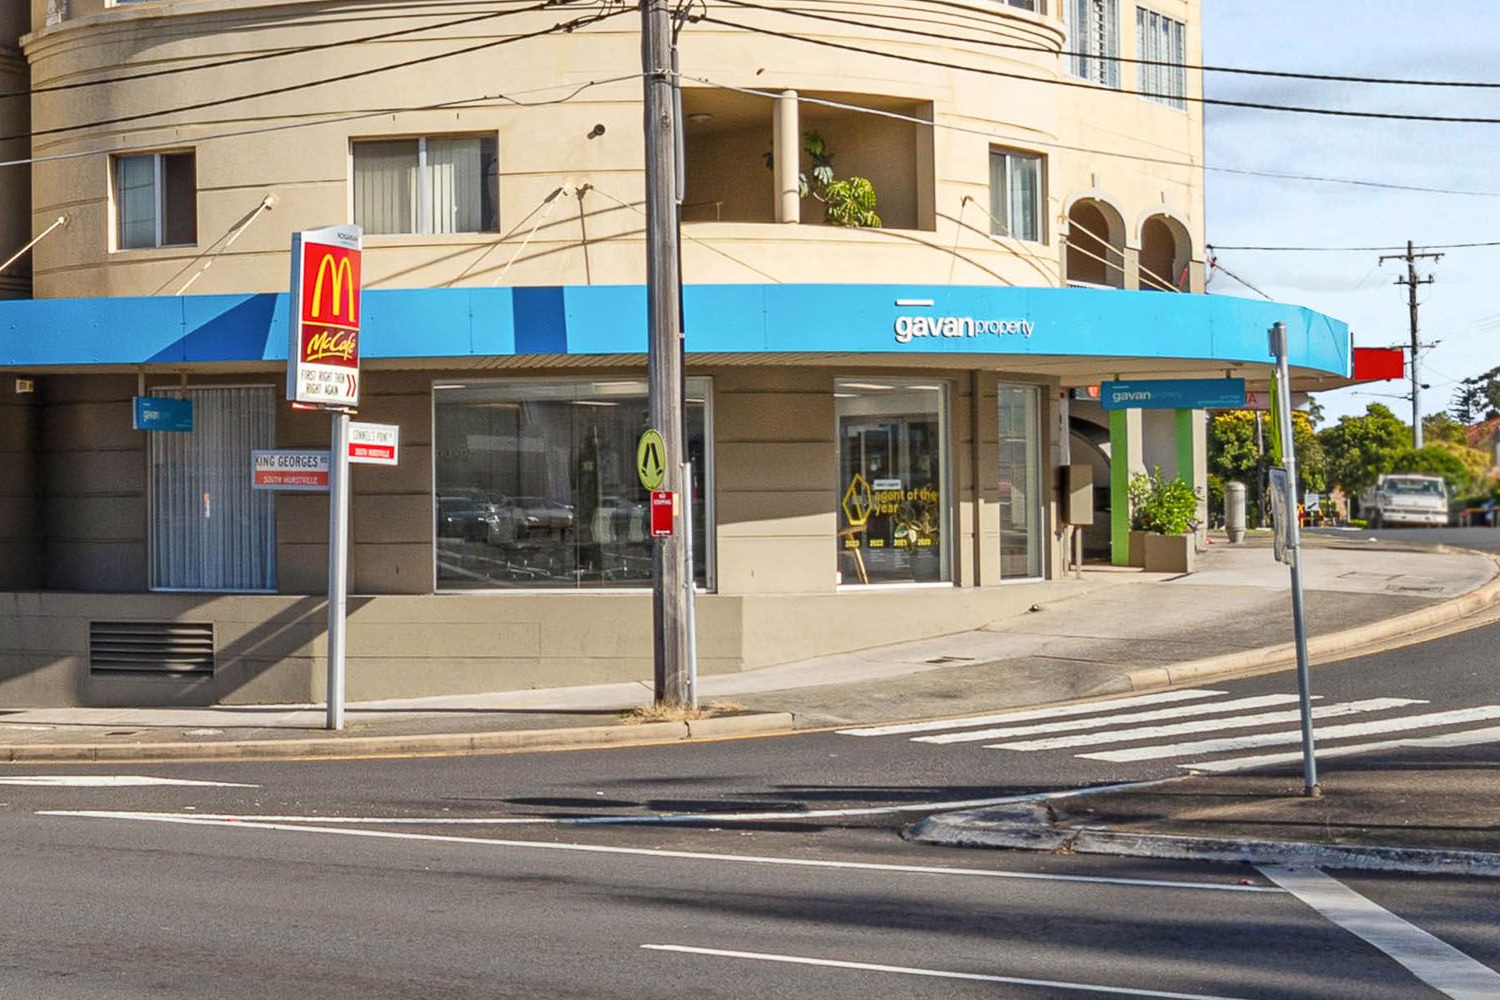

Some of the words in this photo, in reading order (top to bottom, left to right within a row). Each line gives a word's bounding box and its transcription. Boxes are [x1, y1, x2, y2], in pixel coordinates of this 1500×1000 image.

[894, 315, 975, 343] gavan
[975, 318, 1034, 338] property
[306, 330, 356, 361] McCafé
[318, 371, 333, 382] RIGHT
[306, 383, 321, 394] RIGHT
[324, 384, 339, 395] AGAIN
[1111, 390, 1151, 403] gavan
[256, 454, 275, 468] KING
[277, 455, 318, 468] GEORGES
[263, 475, 282, 484] SOUTH
[283, 475, 318, 485] HURSTVILLE
[874, 488, 905, 503] agent
[907, 487, 919, 501] of
[920, 488, 938, 501] the
[874, 503, 899, 517] year
